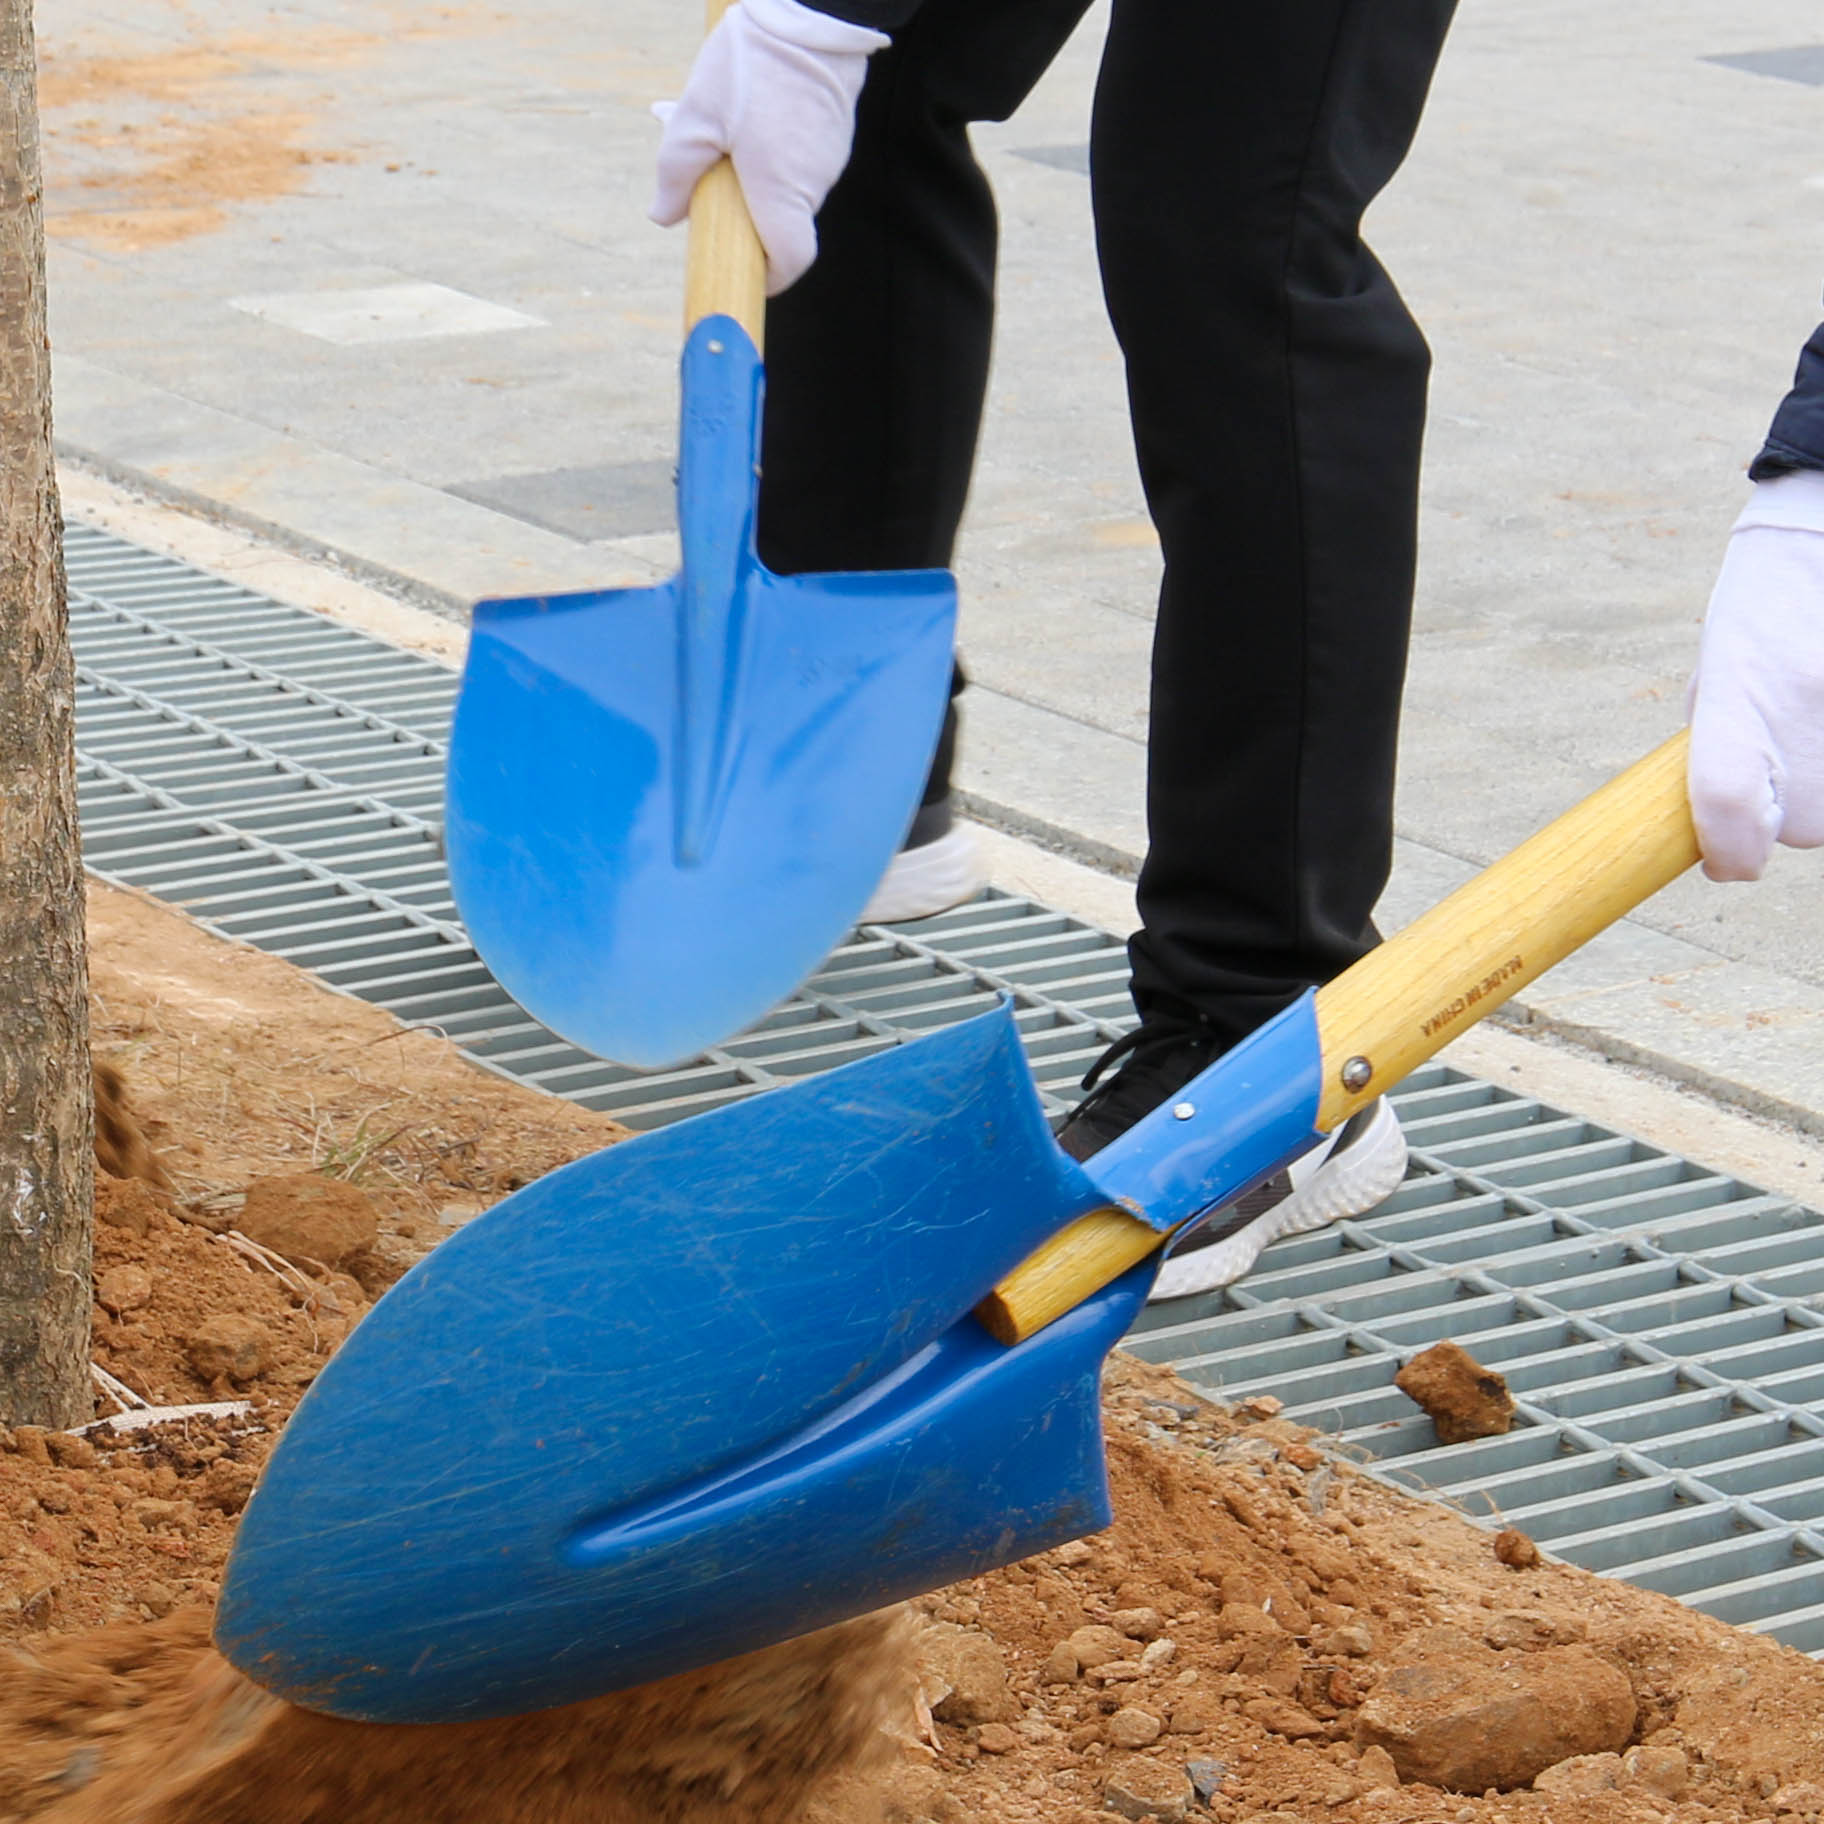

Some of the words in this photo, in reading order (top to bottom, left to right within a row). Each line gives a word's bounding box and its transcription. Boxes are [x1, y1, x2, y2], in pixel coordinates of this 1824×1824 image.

[1464, 984, 1483, 1007] IN
[1479, 954, 1523, 997] MADE
[1419, 997, 1466, 1037] CHINA
